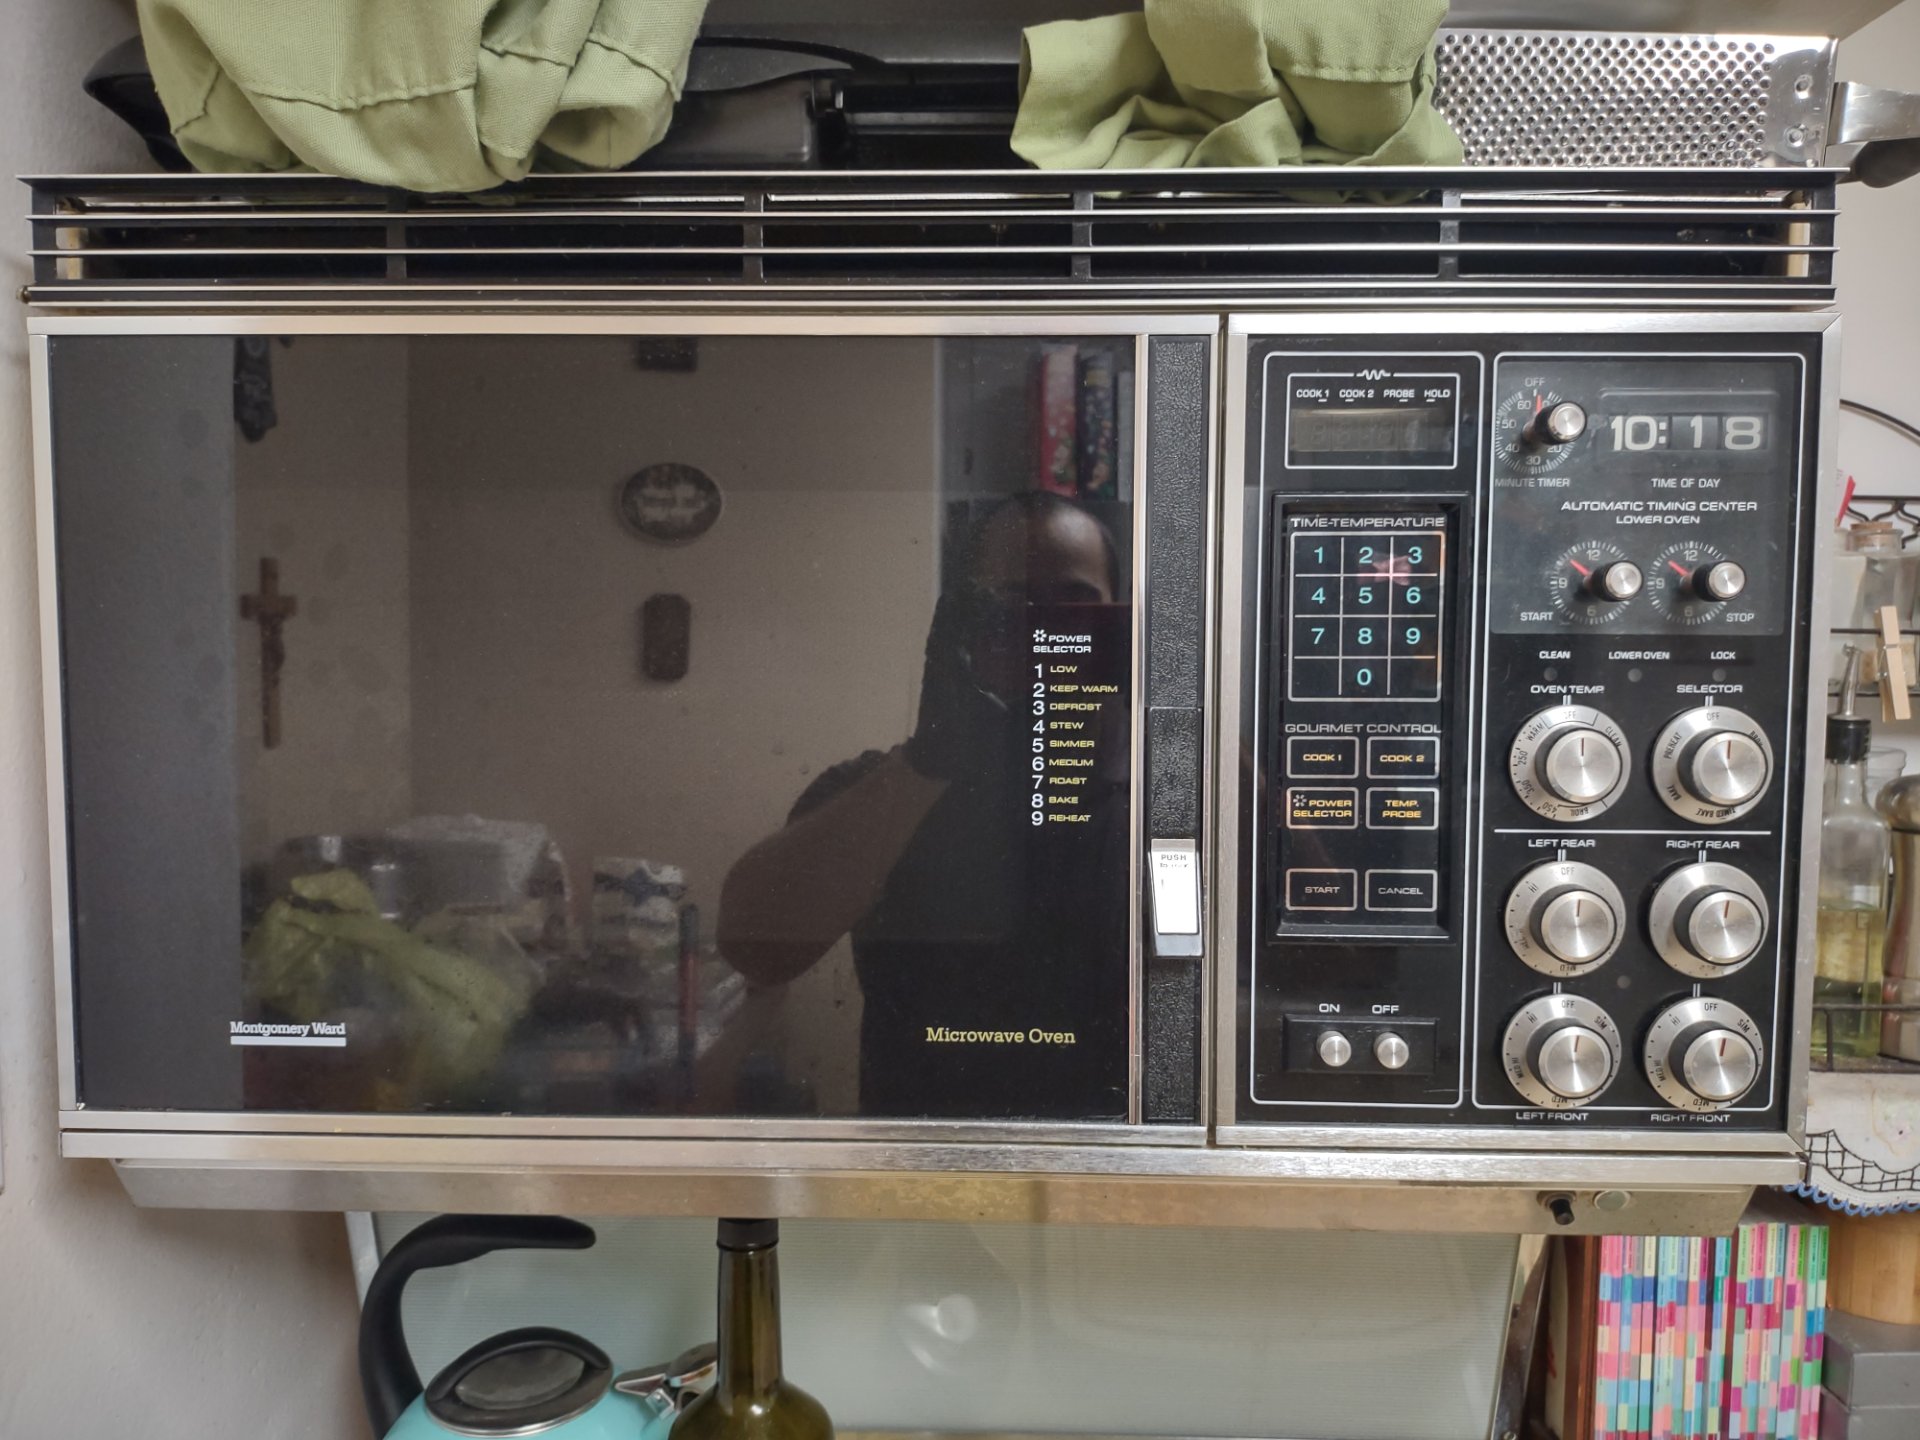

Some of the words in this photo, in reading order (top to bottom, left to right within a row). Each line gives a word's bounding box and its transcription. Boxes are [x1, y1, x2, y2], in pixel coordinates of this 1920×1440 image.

[1525, 378, 1545, 387] OFF
[1295, 389, 1323, 398] COOK
[1339, 389, 1365, 398] COOK
[1366, 389, 1374, 398] 2
[1383, 389, 1415, 398] PROBE
[1424, 389, 1450, 398] HOLD
[1517, 401, 1531, 410] 60
[1502, 420, 1516, 429] 50
[1505, 443, 1520, 453] 40
[1547, 443, 1562, 453] 20
[1526, 456, 1541, 465] 30
[1494, 479, 1536, 487] MINUTE
[1538, 479, 1570, 487] TIMER
[1651, 478, 1677, 488] TIME
[1680, 478, 1695, 488] OF
[1698, 478, 1720, 488] DAY
[1561, 502, 1644, 511] AUTOMATIC
[1647, 502, 1696, 511] TIMING
[1699, 502, 1757, 511] CENTER
[1290, 517, 1445, 528] TIME-TEMPERATURE
[1616, 515, 1662, 524] LOWER
[1664, 515, 1700, 524] OVEN
[1314, 547, 1323, 563] 1
[1359, 547, 1373, 563] 2
[1408, 547, 1422, 563] 3
[1586, 551, 1600, 561] 12
[1684, 551, 1698, 561] 12
[1558, 578, 1567, 588] 9
[1656, 578, 1665, 588] 9
[1311, 587, 1326, 604] 4
[1358, 587, 1373, 604] 5
[1406, 587, 1421, 604] 6
[1587, 606, 1596, 616] 6
[1684, 606, 1693, 617] 6
[1520, 612, 1553, 621] START
[1726, 613, 1754, 622] STOP
[1311, 628, 1325, 644] 7
[1357, 628, 1372, 644] 8
[1406, 628, 1421, 644] 9
[1033, 645, 1091, 653] SELECTOR
[1539, 651, 1570, 659] CLEAN
[1608, 652, 1641, 660] LOWER
[1643, 652, 1670, 660] OVEN
[1711, 652, 1736, 660] LOCK
[1034, 664, 1043, 678] 1
[1357, 669, 1372, 685] 0
[1033, 683, 1045, 697] 2
[1530, 685, 1567, 693] OVEN
[1676, 685, 1743, 693] SELECTOR
[1032, 701, 1045, 715] 3
[1050, 703, 1102, 711] DEFROST
[1706, 712, 1720, 721] OFF
[1033, 719, 1045, 734] 4
[1285, 724, 1364, 733] GOURMET
[1366, 724, 1442, 734] CONTROL
[1527, 724, 1544, 742] WARM
[1605, 726, 1623, 748] CLEAN
[1032, 738, 1044, 753] 5
[1664, 732, 1682, 759] PREHEAT
[1303, 754, 1335, 762] COOK
[1379, 755, 1413, 763] COOK
[1518, 751, 1528, 765] 250
[1032, 757, 1045, 772] 6
[1032, 775, 1044, 789] 7
[1521, 780, 1535, 795] 350
[1031, 793, 1044, 808] 8
[1542, 802, 1557, 813] 450
[1293, 810, 1353, 818] SELECTOR
[1696, 808, 1714, 818] BAKE
[1031, 811, 1044, 826] 9
[1560, 840, 1596, 848] REAR
[1665, 840, 1703, 848] RIGHT
[1705, 841, 1740, 849] REAR
[1561, 867, 1575, 875] OFF
[1305, 886, 1340, 894] START
[1378, 887, 1423, 895] CANCEL
[1319, 1003, 1340, 1013] ON
[1562, 1000, 1576, 1008] OFF
[1704, 1002, 1718, 1011] OFF
[1372, 1005, 1399, 1014] OFF
[1528, 1014, 1537, 1024] HI
[1594, 1016, 1607, 1030] SIM
[1671, 1016, 1680, 1026] HI
[230, 1021, 310, 1037] Montgomery
[311, 1022, 346, 1035] Ward
[1737, 1019, 1750, 1033] SIM
[925, 1027, 1025, 1042] Microwave
[1028, 1028, 1076, 1043] Oven
[1693, 1098, 1709, 1106] MED
[1516, 1112, 1545, 1120] LEFT
[1548, 1113, 1589, 1121] FRONT
[1651, 1114, 1686, 1122] RIGHT
